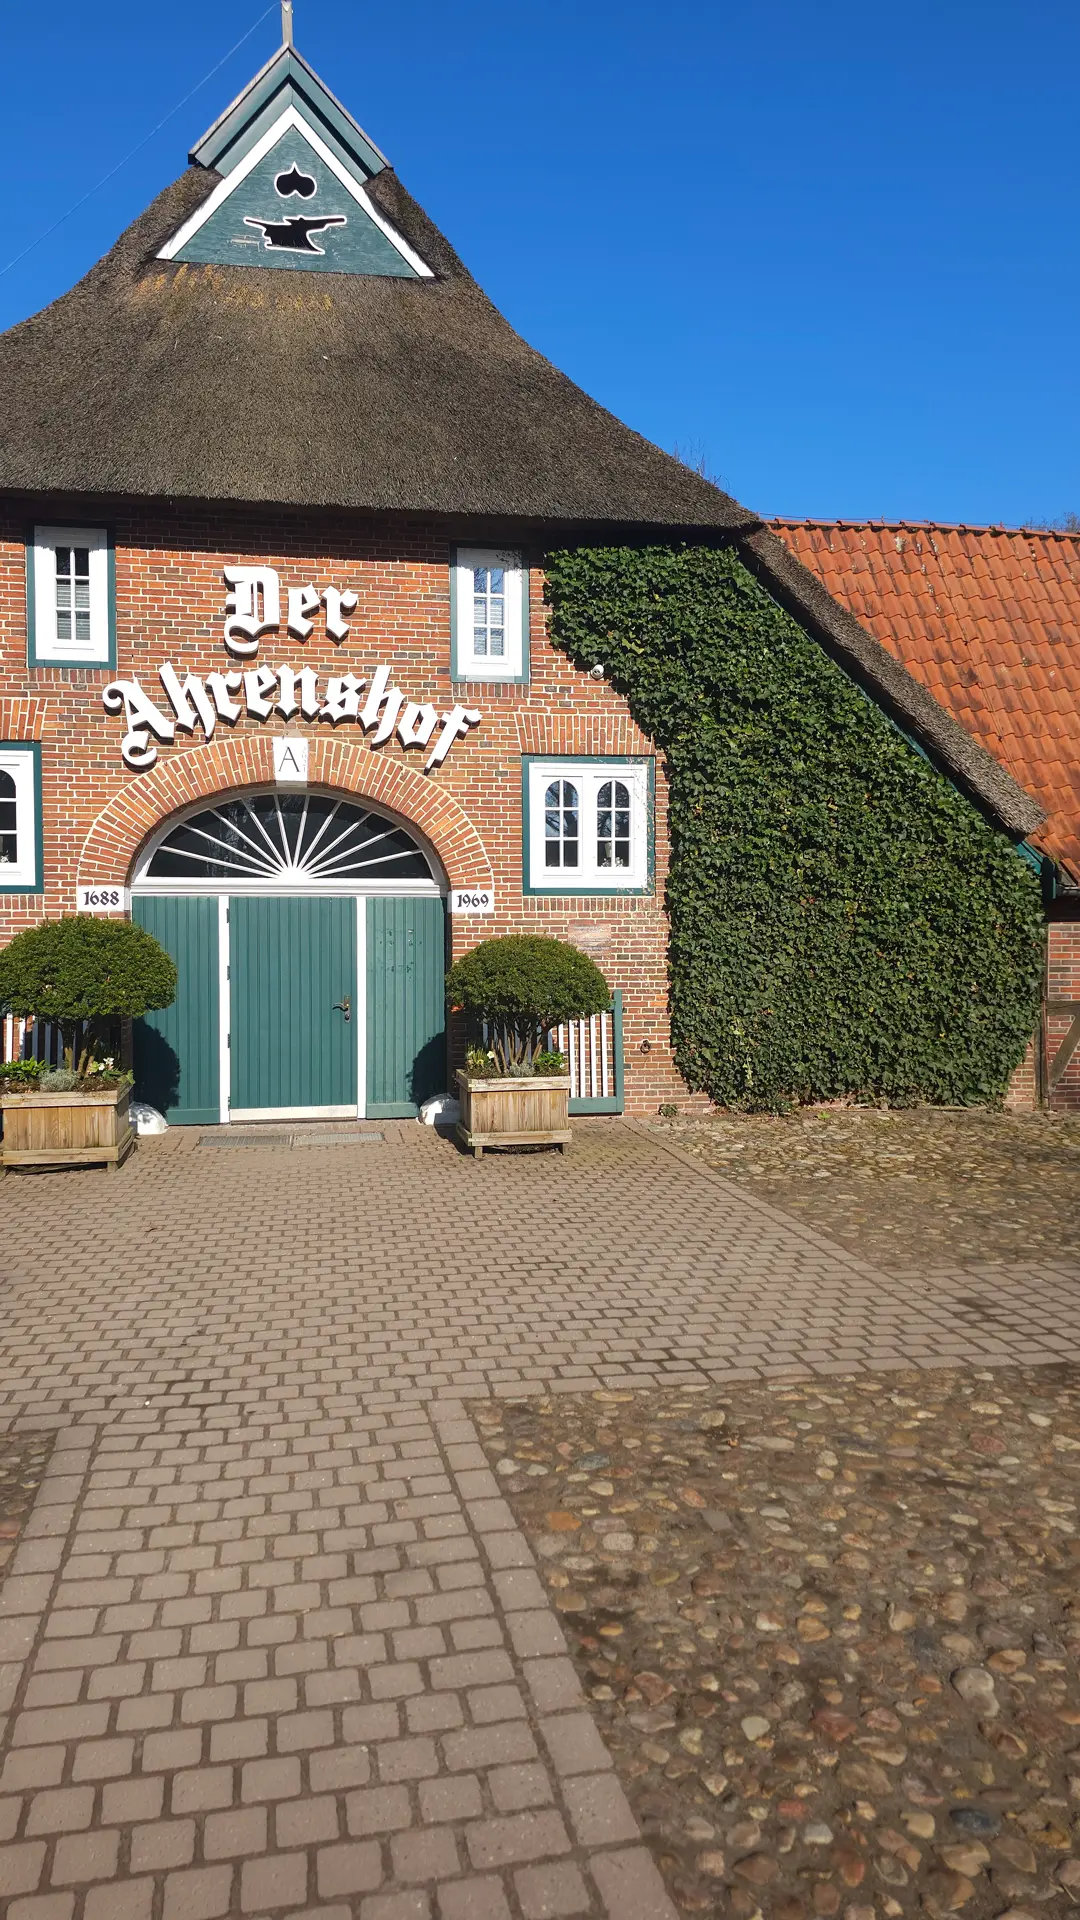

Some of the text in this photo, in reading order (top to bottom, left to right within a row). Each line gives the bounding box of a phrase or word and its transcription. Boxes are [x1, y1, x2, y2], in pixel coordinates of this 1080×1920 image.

[223, 565, 359, 655] Der
[102, 660, 483, 771] Ahrenshof
[278, 745, 301, 773] A
[83, 890, 120, 906] 1688
[456, 893, 490, 908] 1969
